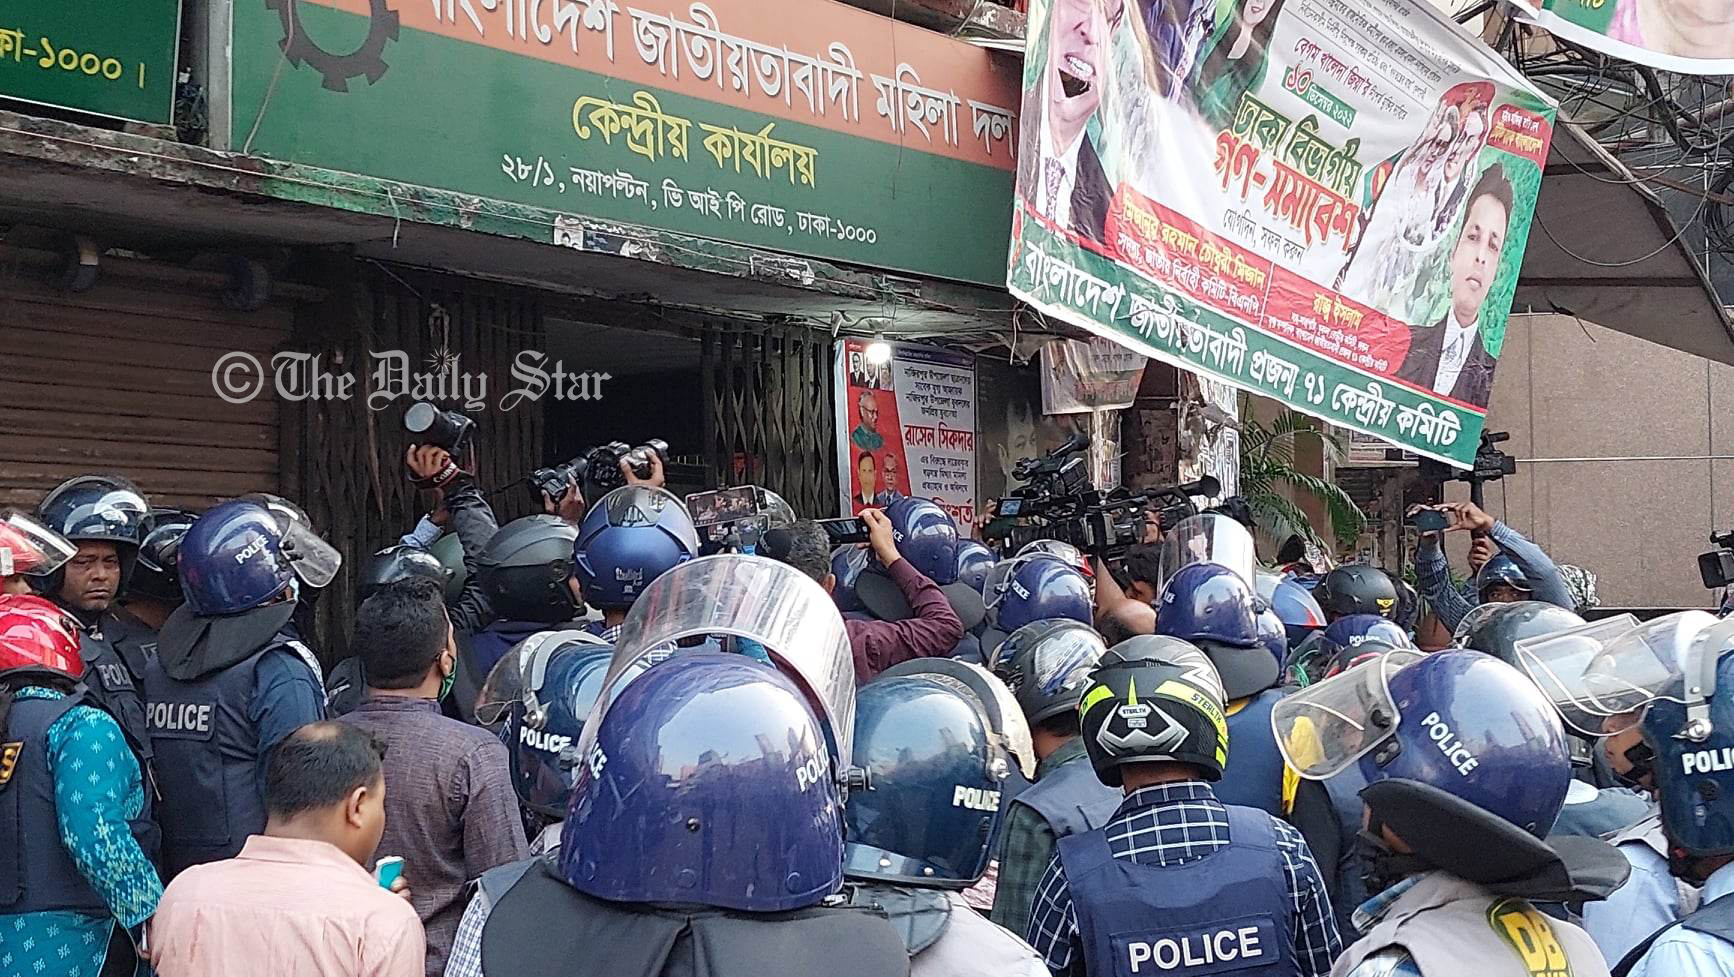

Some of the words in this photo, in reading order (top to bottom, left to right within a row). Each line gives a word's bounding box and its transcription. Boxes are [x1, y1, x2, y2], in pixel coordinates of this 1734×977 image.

[431, 0, 620, 63] লাদেশ
[627, 1, 863, 123] জাতীয়তাবাদী
[870, 63, 961, 147] মহিলা
[968, 99, 1017, 159] দল
[1295, 38, 1321, 63] বেগম
[1319, 51, 1353, 87] খালেদা
[1285, 64, 1313, 95] ১০
[1332, 105, 1354, 126] ২০২২
[572, 91, 693, 163] কেন্দ্রীয়
[699, 123, 818, 188] কার্যালয়
[1233, 90, 1292, 156] ঢাকা
[1284, 114, 1363, 199] বিভাগীয়
[661, 178, 684, 208] ভি
[687, 187, 722, 220] আই
[726, 192, 746, 222] পি
[797, 211, 877, 244] ঢাকা-১০০০
[1161, 222, 1199, 257] রহমান
[1199, 242, 1232, 276] চৌধুরী
[1231, 254, 1267, 290] মিজান
[1025, 240, 1127, 324] বাংলাদেশ
[1129, 294, 1248, 377] জাতীয়তাবাদী
[1250, 349, 1300, 400] প্রজন্ম
[1303, 371, 1326, 405] ৭১
[1331, 381, 1398, 428] কেন্দ্রীয়
[1396, 402, 1462, 447] কমিটি
[904, 425, 935, 448] রাসেল
[938, 422, 974, 452] সিকদার
[234, 534, 269, 564] POLICE
[146, 702, 211, 732] POLICE
[520, 726, 571, 753] POLICE
[1421, 711, 1479, 776] POLICE
[1681, 747, 1734, 775] POLI
[1128, 926, 1262, 972] POLICE
[1499, 911, 1567, 971] DB
